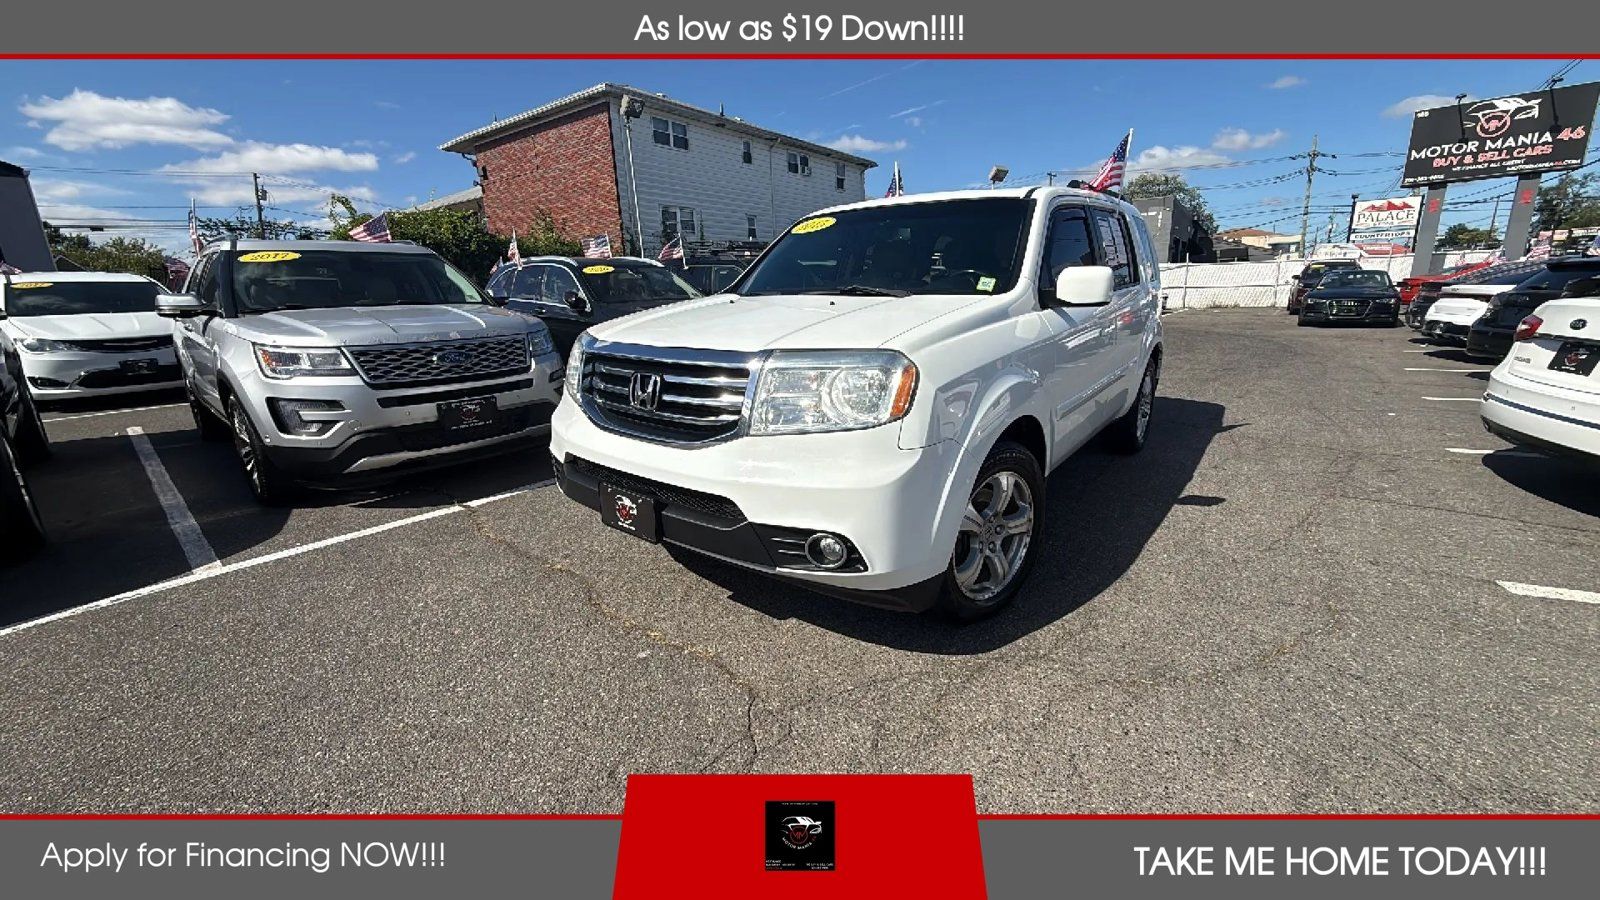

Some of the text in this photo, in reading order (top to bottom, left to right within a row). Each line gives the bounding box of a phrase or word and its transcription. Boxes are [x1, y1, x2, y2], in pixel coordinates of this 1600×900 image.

[1410, 126, 1587, 161] MOTOR MANIA 46
[1432, 144, 1555, 167] BUY & SELL CARS
[1357, 209, 1416, 223] PALACE
[250, 252, 290, 261] 2017
